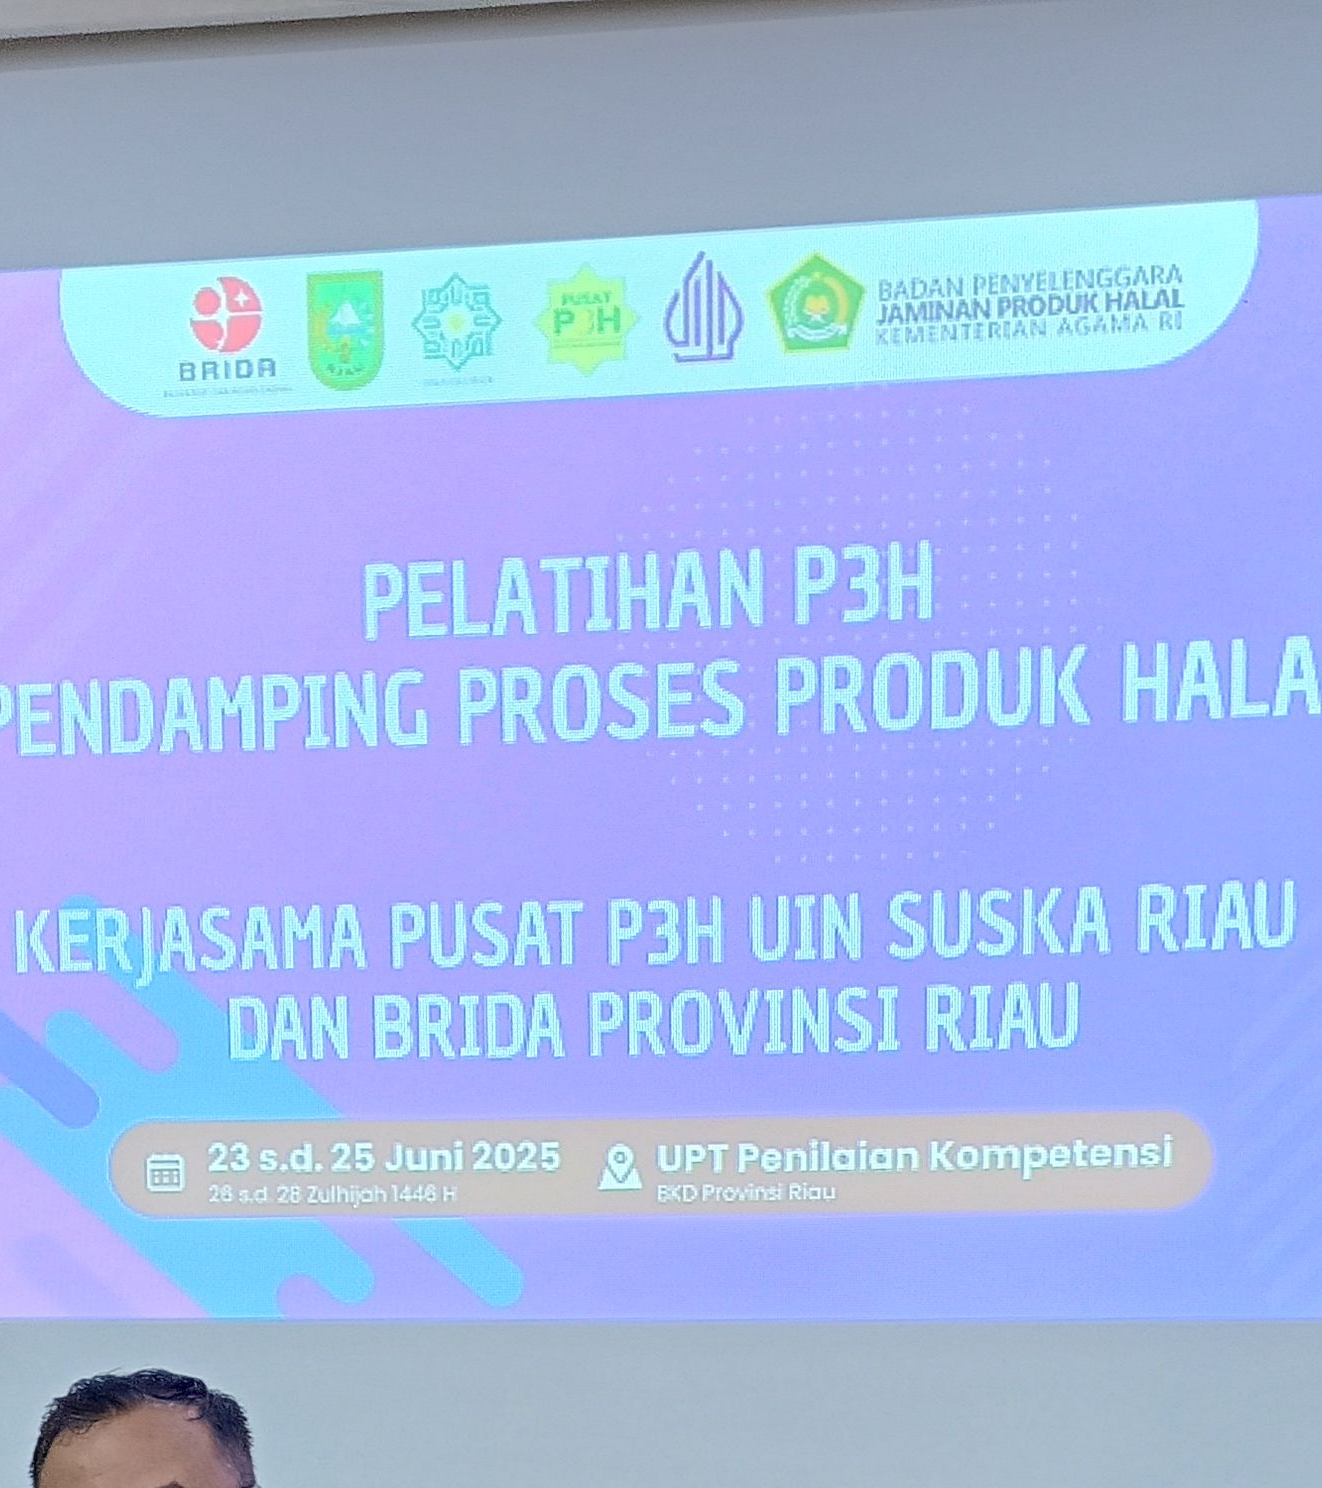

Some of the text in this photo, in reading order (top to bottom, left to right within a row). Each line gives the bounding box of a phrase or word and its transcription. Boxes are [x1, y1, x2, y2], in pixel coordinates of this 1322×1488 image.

[878, 264, 1183, 302] BADAN PENYELENGGARA
[876, 288, 1185, 326] JAMINAN PRODUK HALAL
[876, 310, 1183, 346] KEMENTERIAN AGAMA RI
[179, 358, 276, 382] BRIDA
[364, 539, 933, 641] PELATIHAN P3H
[459, 658, 744, 745] PROSES
[775, 644, 1090, 736] PRODUK
[15, 878, 1296, 988] KERJASAMA PUSAT P3H UIN SUSKA RIAU
[228, 981, 1078, 1061] DAN BRIDA PROVINSI RIAU
[208, 1141, 560, 1173] 23 s.d. 25 Juni 2025
[657, 1134, 1173, 1180] UPT Penilaian Kompetensi
[307, 1184, 386, 1208] Zulhijah
[443, 1185, 458, 1202] H
[657, 1182, 836, 1202] BKD Provinsi Riau
